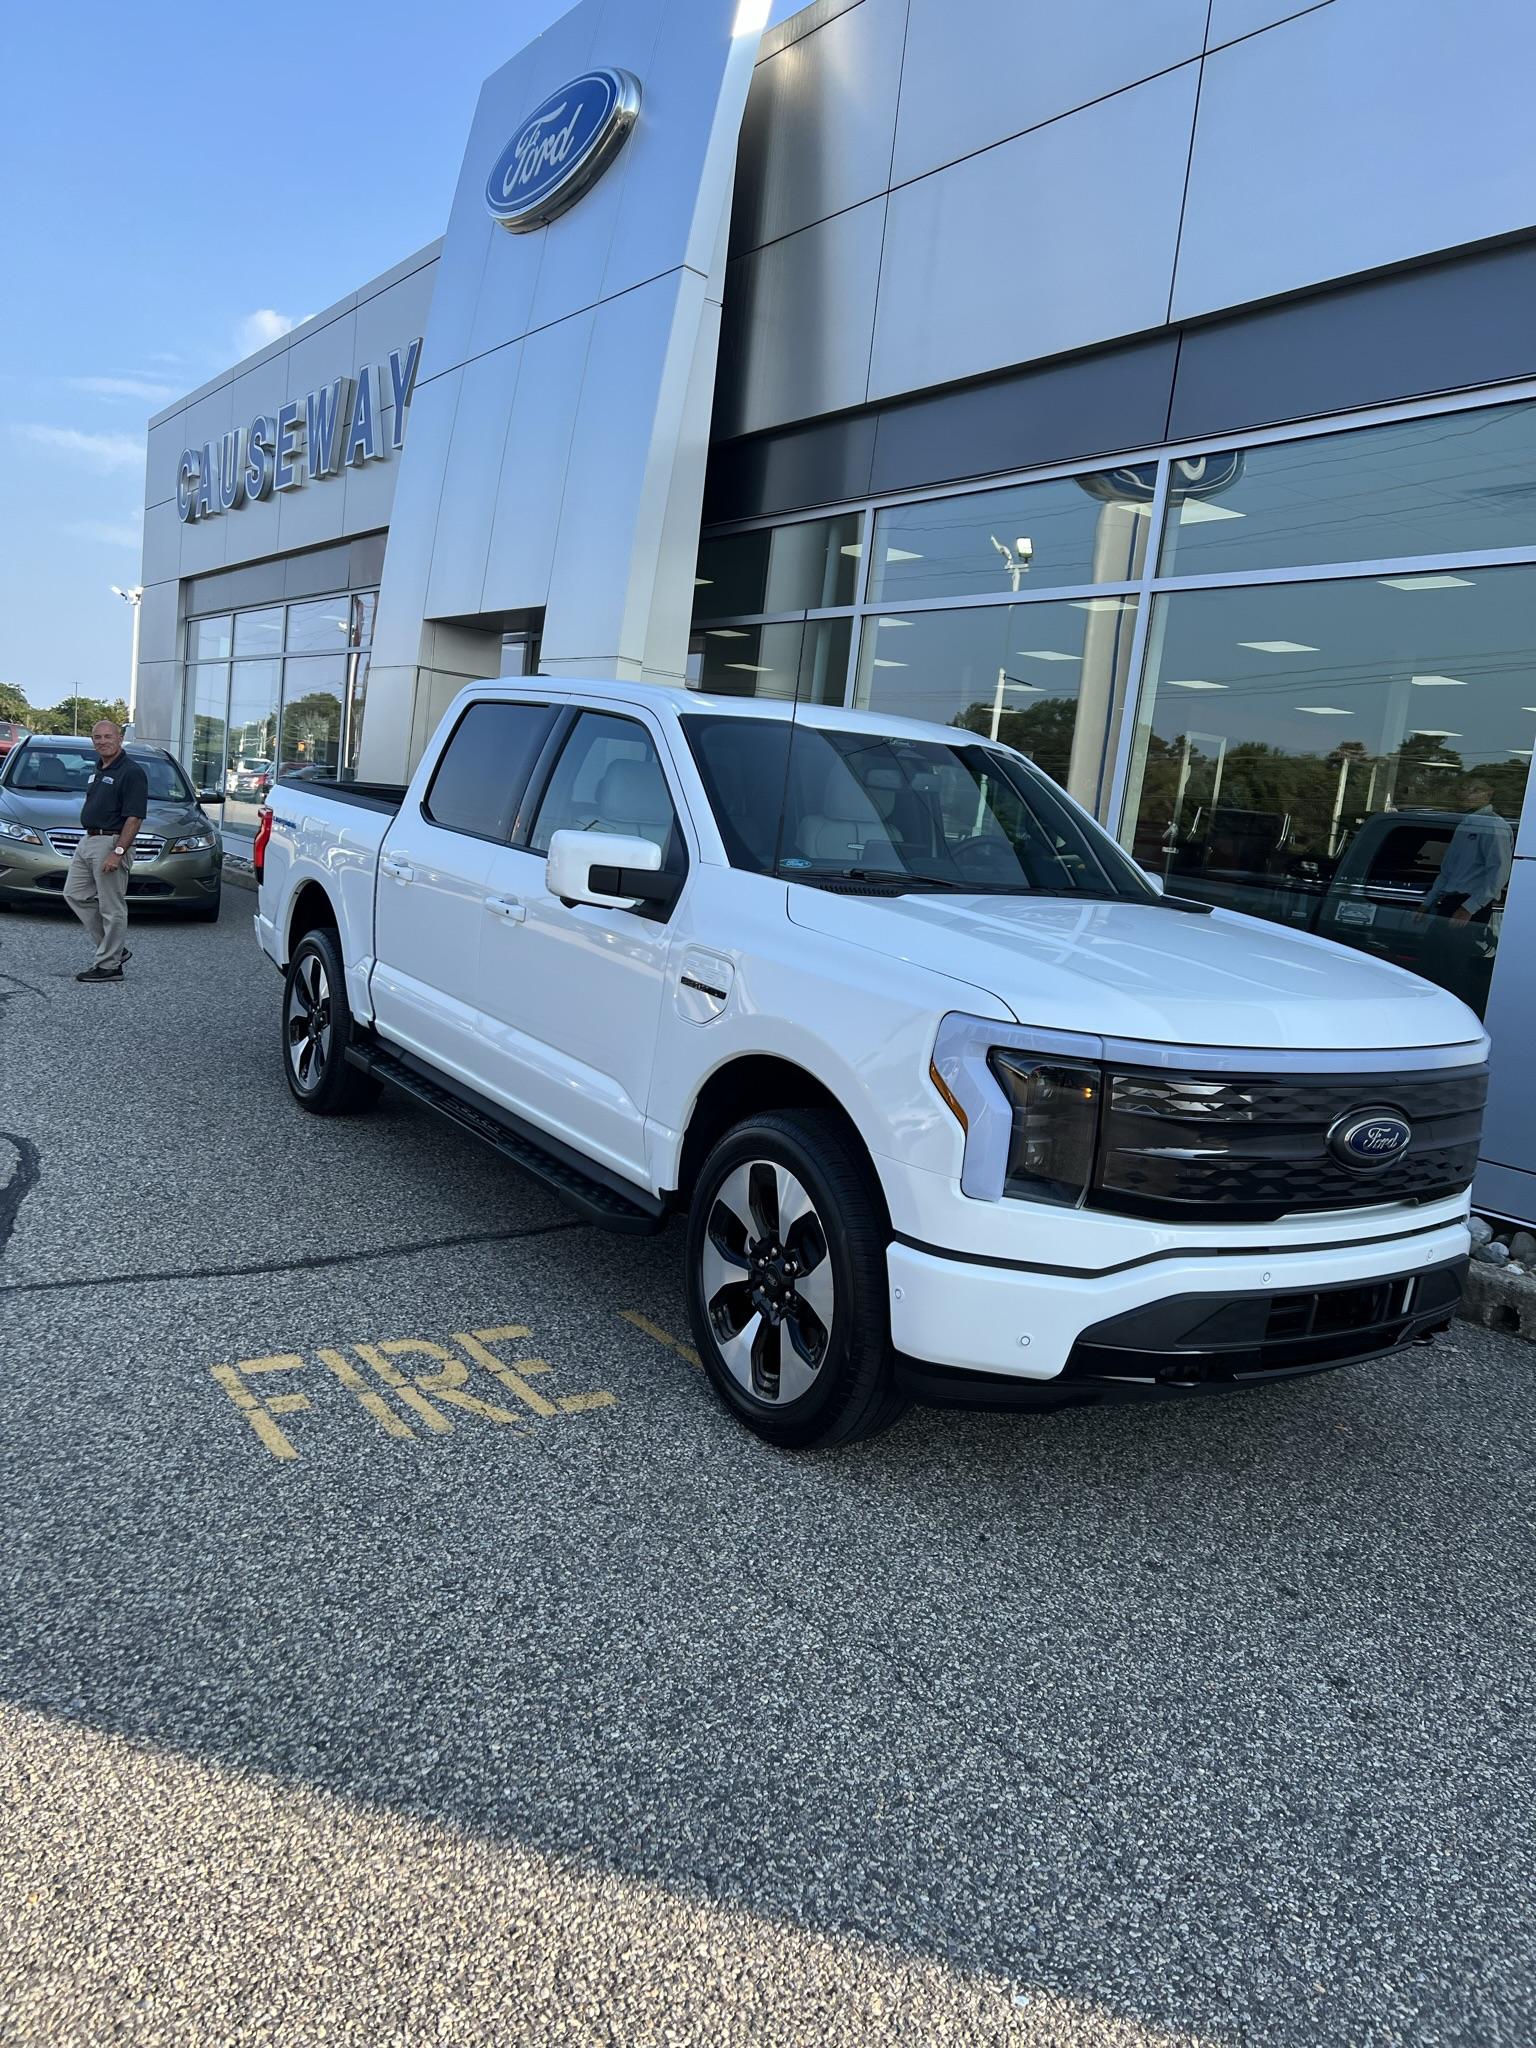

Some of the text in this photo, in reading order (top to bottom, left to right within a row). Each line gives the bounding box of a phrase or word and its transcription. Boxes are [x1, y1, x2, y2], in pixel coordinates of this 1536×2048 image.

[502, 101, 584, 198] Ford
[176, 337, 423, 523] CAUSEWAY
[1362, 1127, 1400, 1150] Ford
[209, 1325, 617, 1460] FIRE
